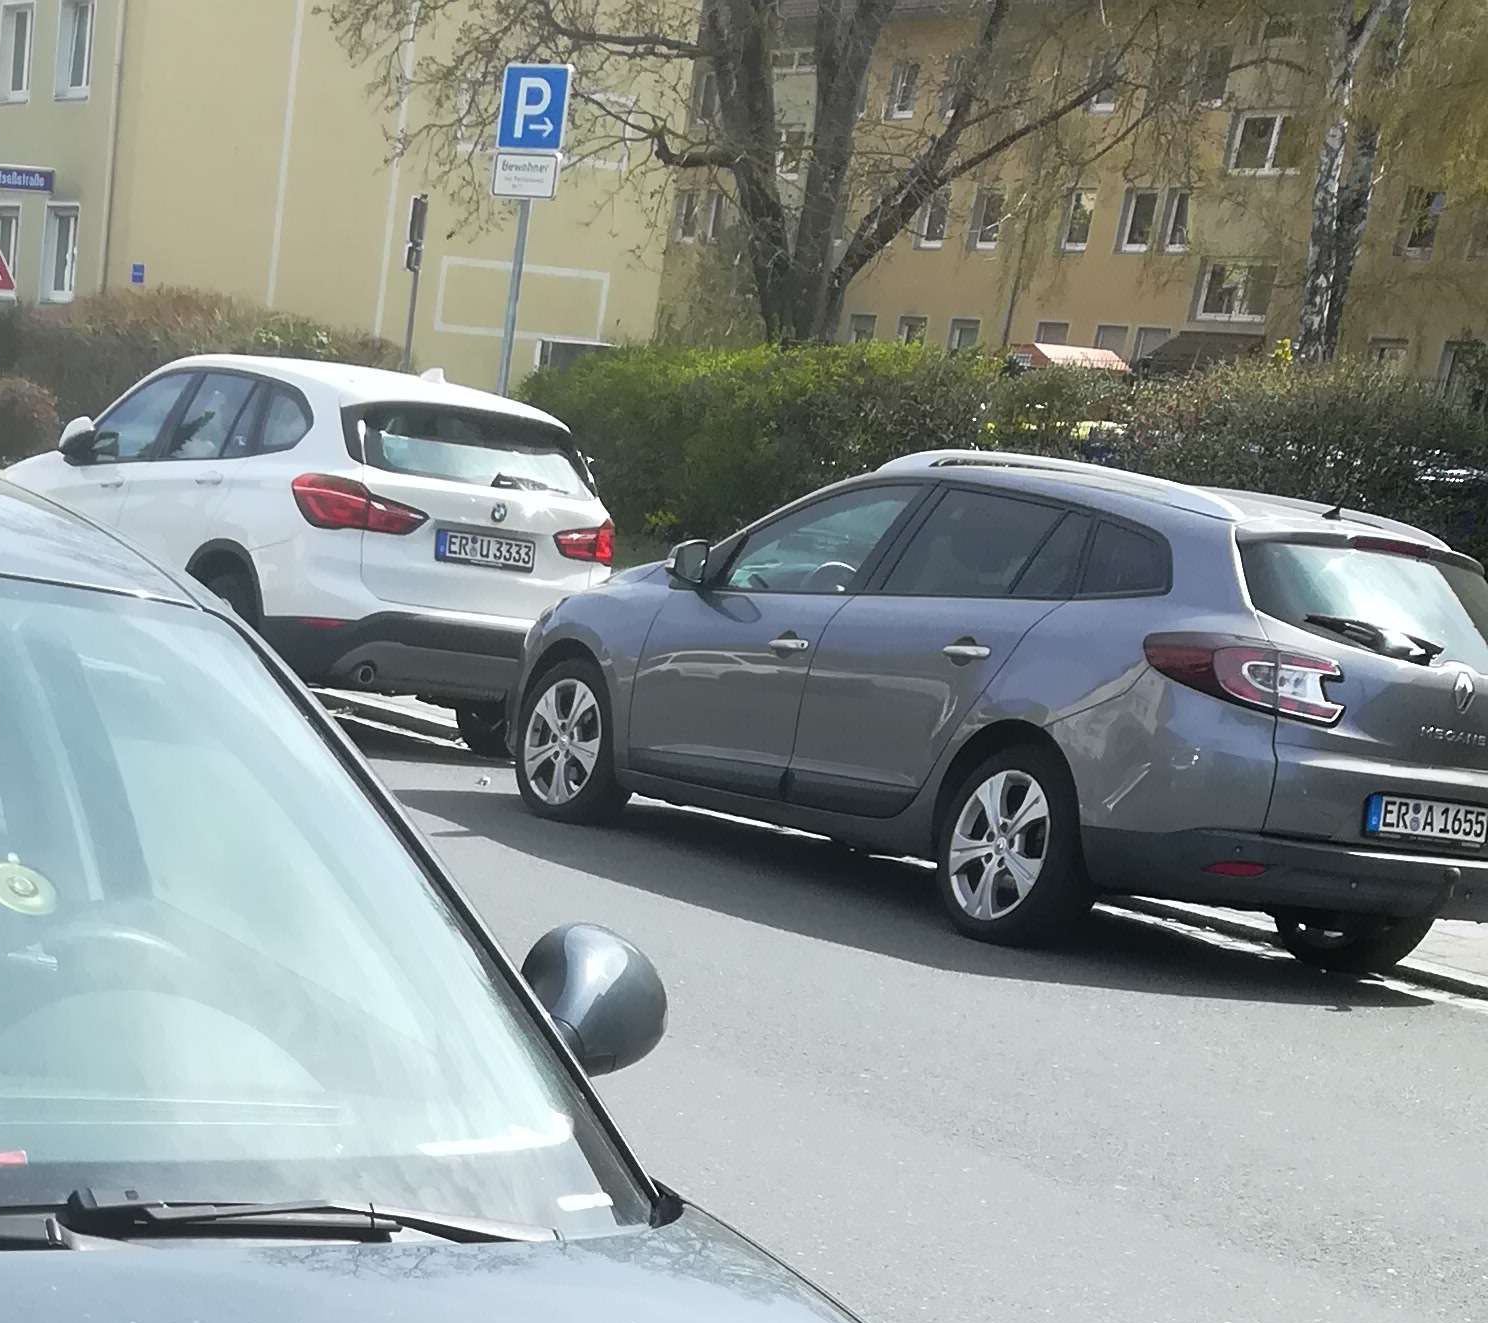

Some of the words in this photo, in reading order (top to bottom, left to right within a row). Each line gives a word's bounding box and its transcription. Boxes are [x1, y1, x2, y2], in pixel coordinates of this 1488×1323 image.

[513, 77, 551, 138] P
[447, 534, 469, 556] ER
[479, 539, 491, 559] U
[493, 540, 532, 565] 3333
[1420, 725, 1487, 746] MEGANE
[1381, 800, 1410, 830] ER
[1422, 805, 1434, 833] A
[1438, 807, 1488, 838] 1655
